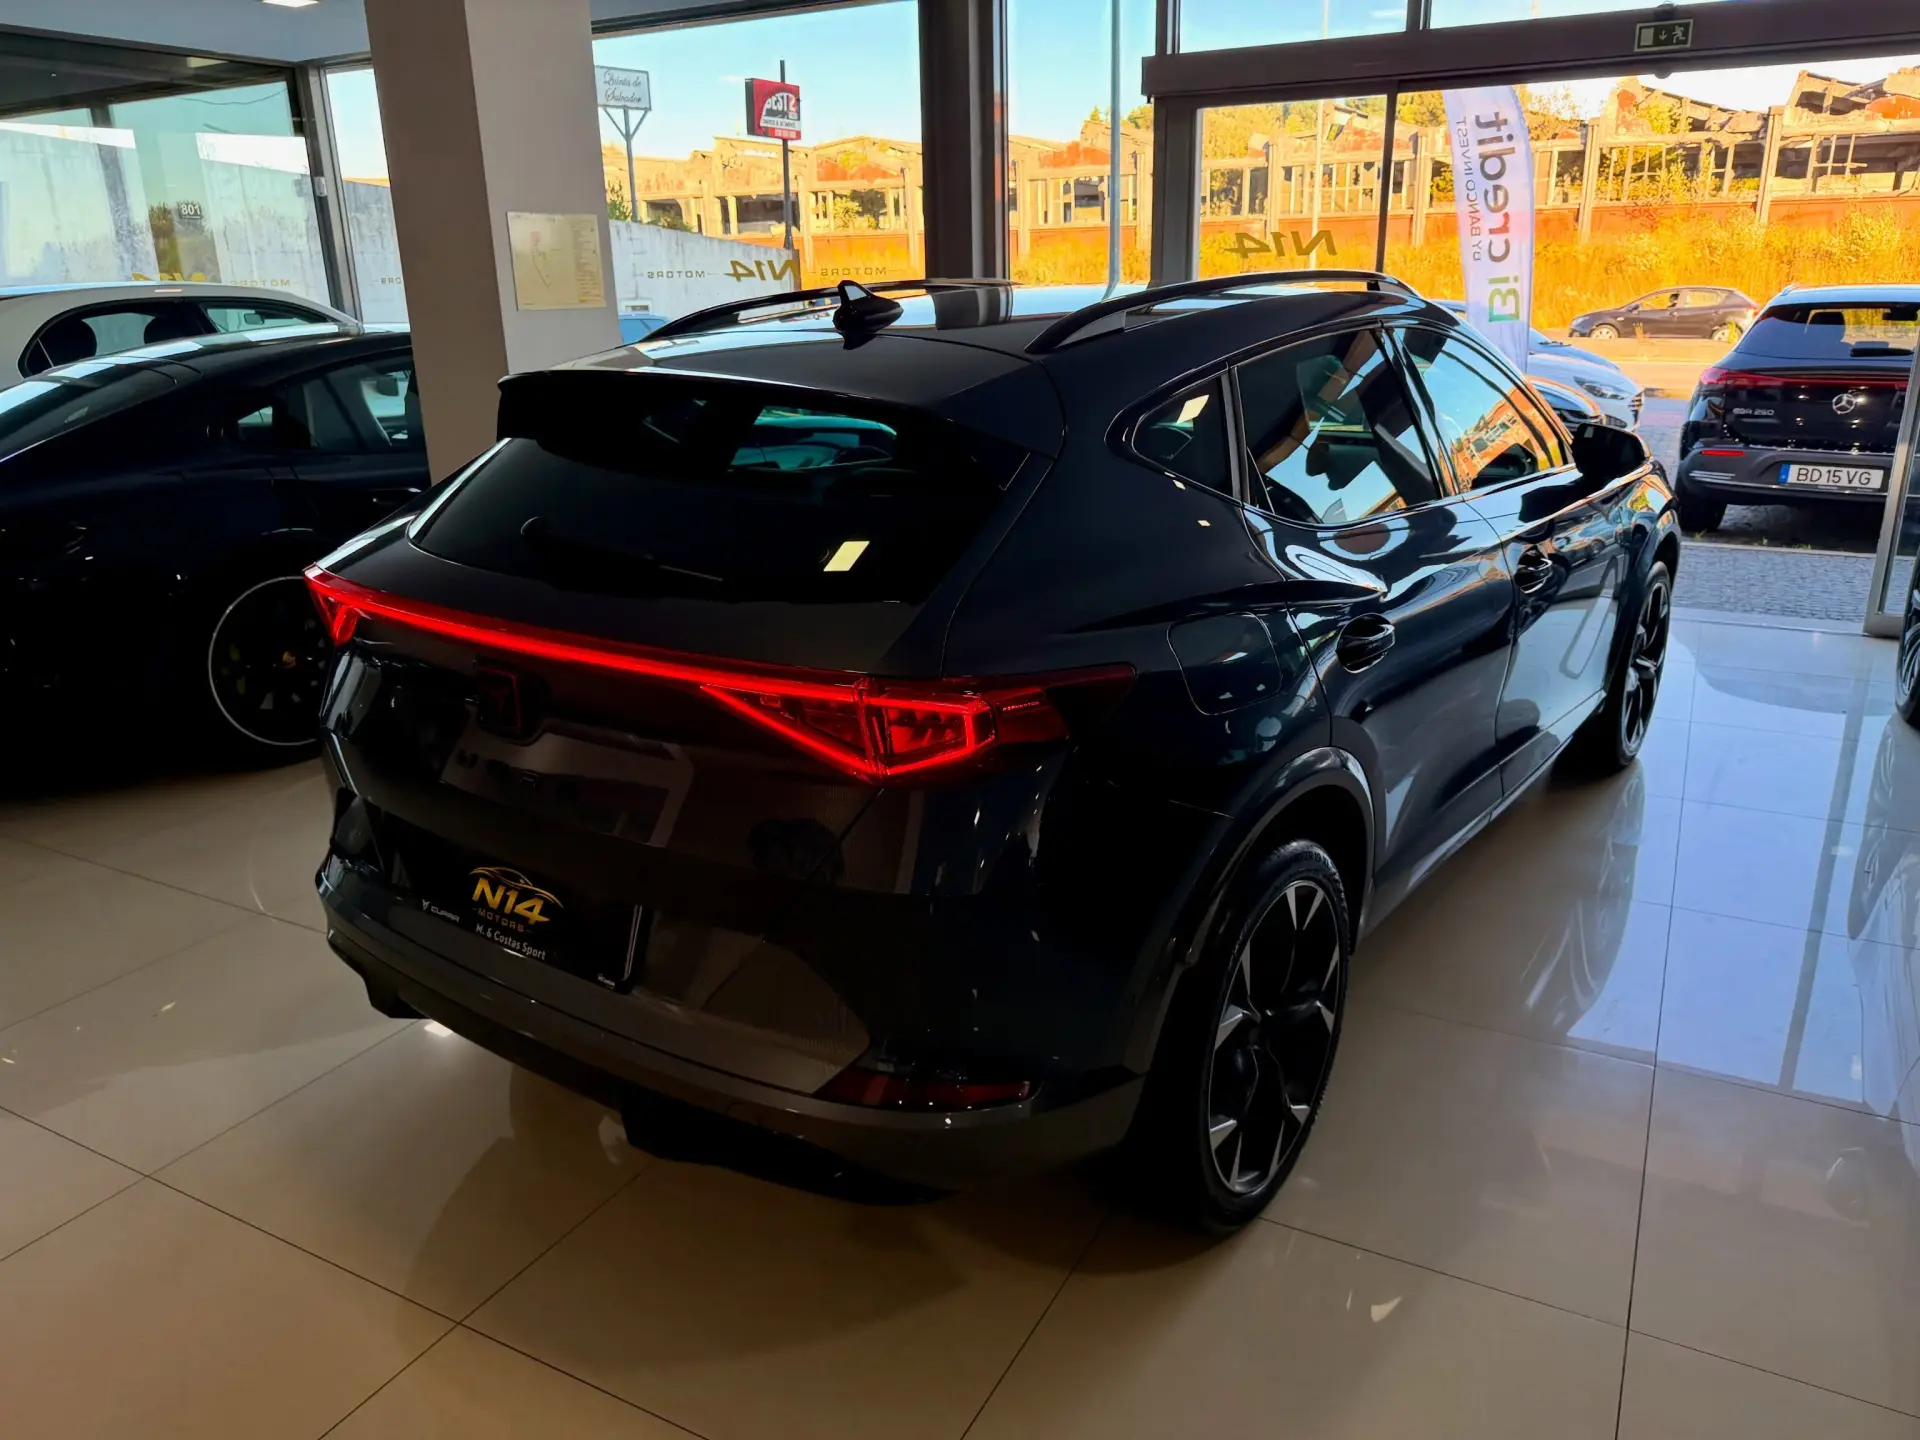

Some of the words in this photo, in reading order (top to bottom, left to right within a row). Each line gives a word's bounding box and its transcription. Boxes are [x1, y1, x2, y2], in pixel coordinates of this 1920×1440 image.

[181, 204, 201, 215] 801
[1796, 467, 1822, 483] BD
[1826, 469, 1842, 484] 15
[1846, 470, 1872, 486] VG
[471, 877, 551, 926] N14
[477, 907, 525, 933] MOTORS
[494, 929, 521, 951] Costas
[521, 941, 546, 961] Sport
